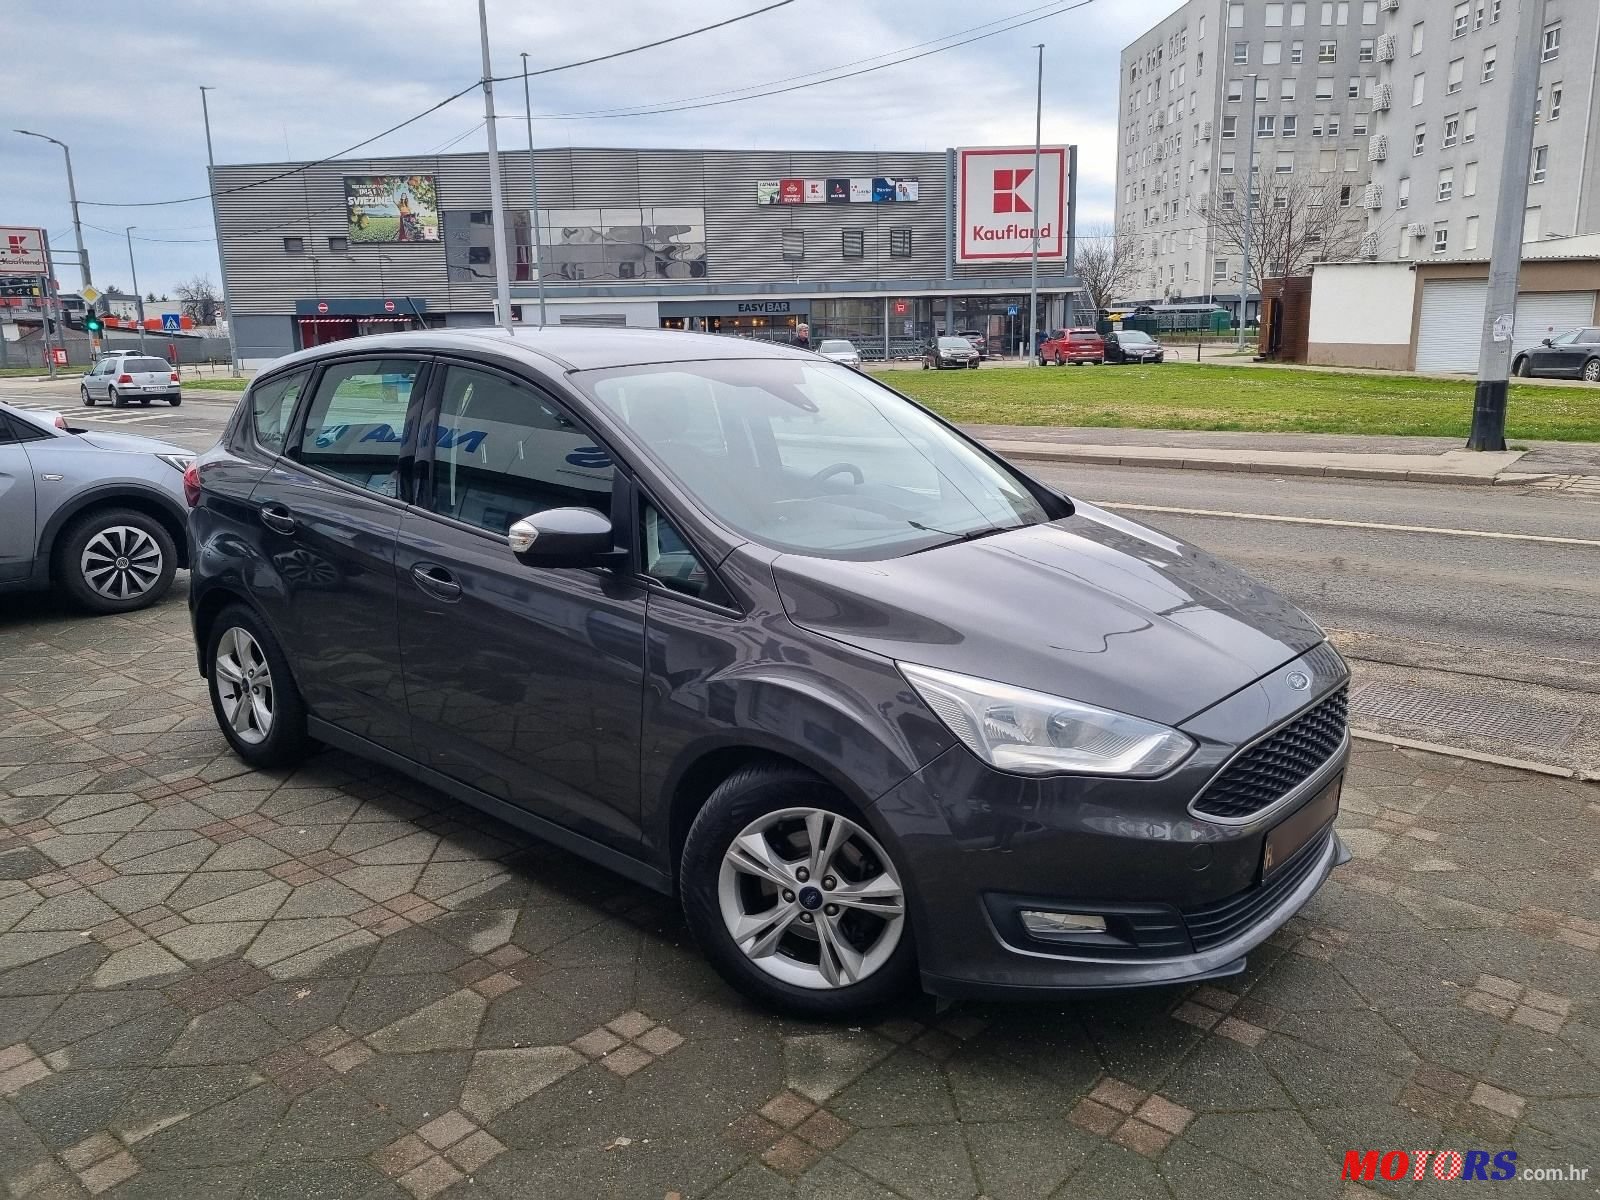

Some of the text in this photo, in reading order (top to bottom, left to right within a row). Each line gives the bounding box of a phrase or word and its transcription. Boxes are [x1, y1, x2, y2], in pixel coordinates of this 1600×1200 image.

[973, 223, 1051, 241] Kaufland
[738, 302, 789, 312] EASY BAR
